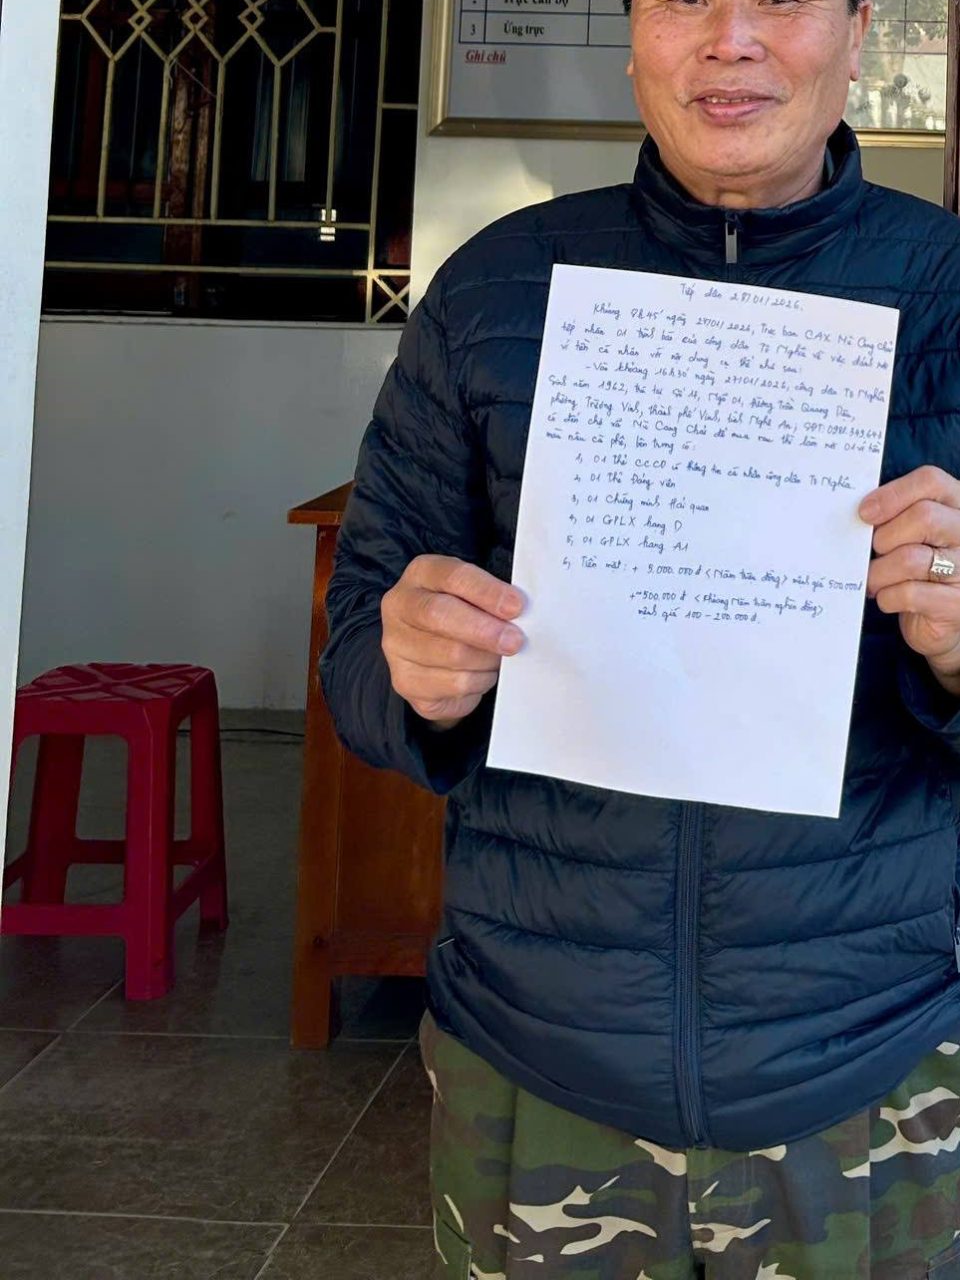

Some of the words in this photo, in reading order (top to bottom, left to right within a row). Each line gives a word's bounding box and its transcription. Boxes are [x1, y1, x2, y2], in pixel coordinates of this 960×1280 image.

[470, 24, 476, 35] 3
[504, 19, 523, 36] Ứng
[525, 25, 544, 37] trực
[465, 50, 485, 63] Ghi
[603, 515, 636, 526] GPLX
[600, 536, 630, 547] GPLX
